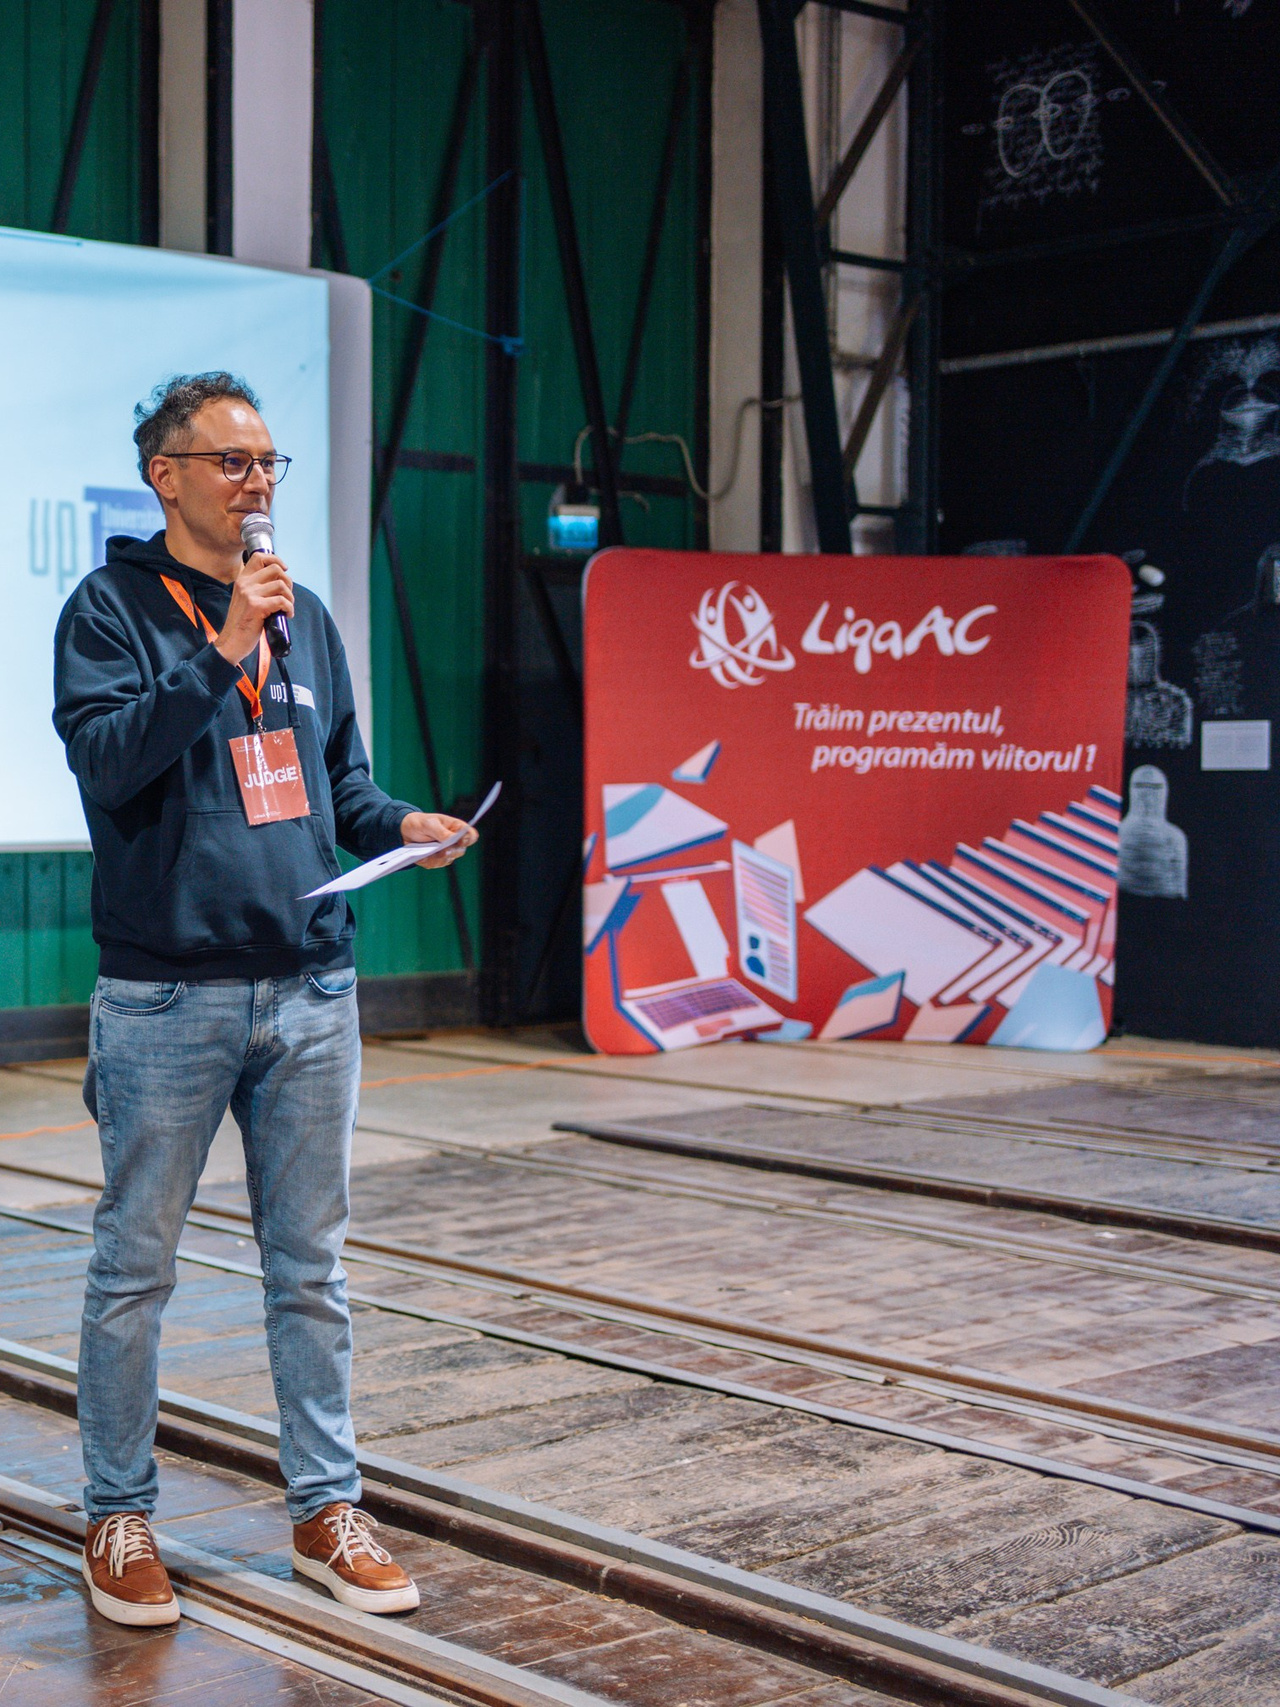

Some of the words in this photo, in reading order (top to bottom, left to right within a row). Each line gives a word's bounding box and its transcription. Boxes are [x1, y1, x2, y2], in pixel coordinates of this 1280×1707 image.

[801, 600, 998, 674] LigaAC
[794, 702, 862, 731] Trăim
[867, 705, 1004, 738] prezentul,
[811, 743, 974, 775] programăm
[244, 766, 299, 788] JUDGE
